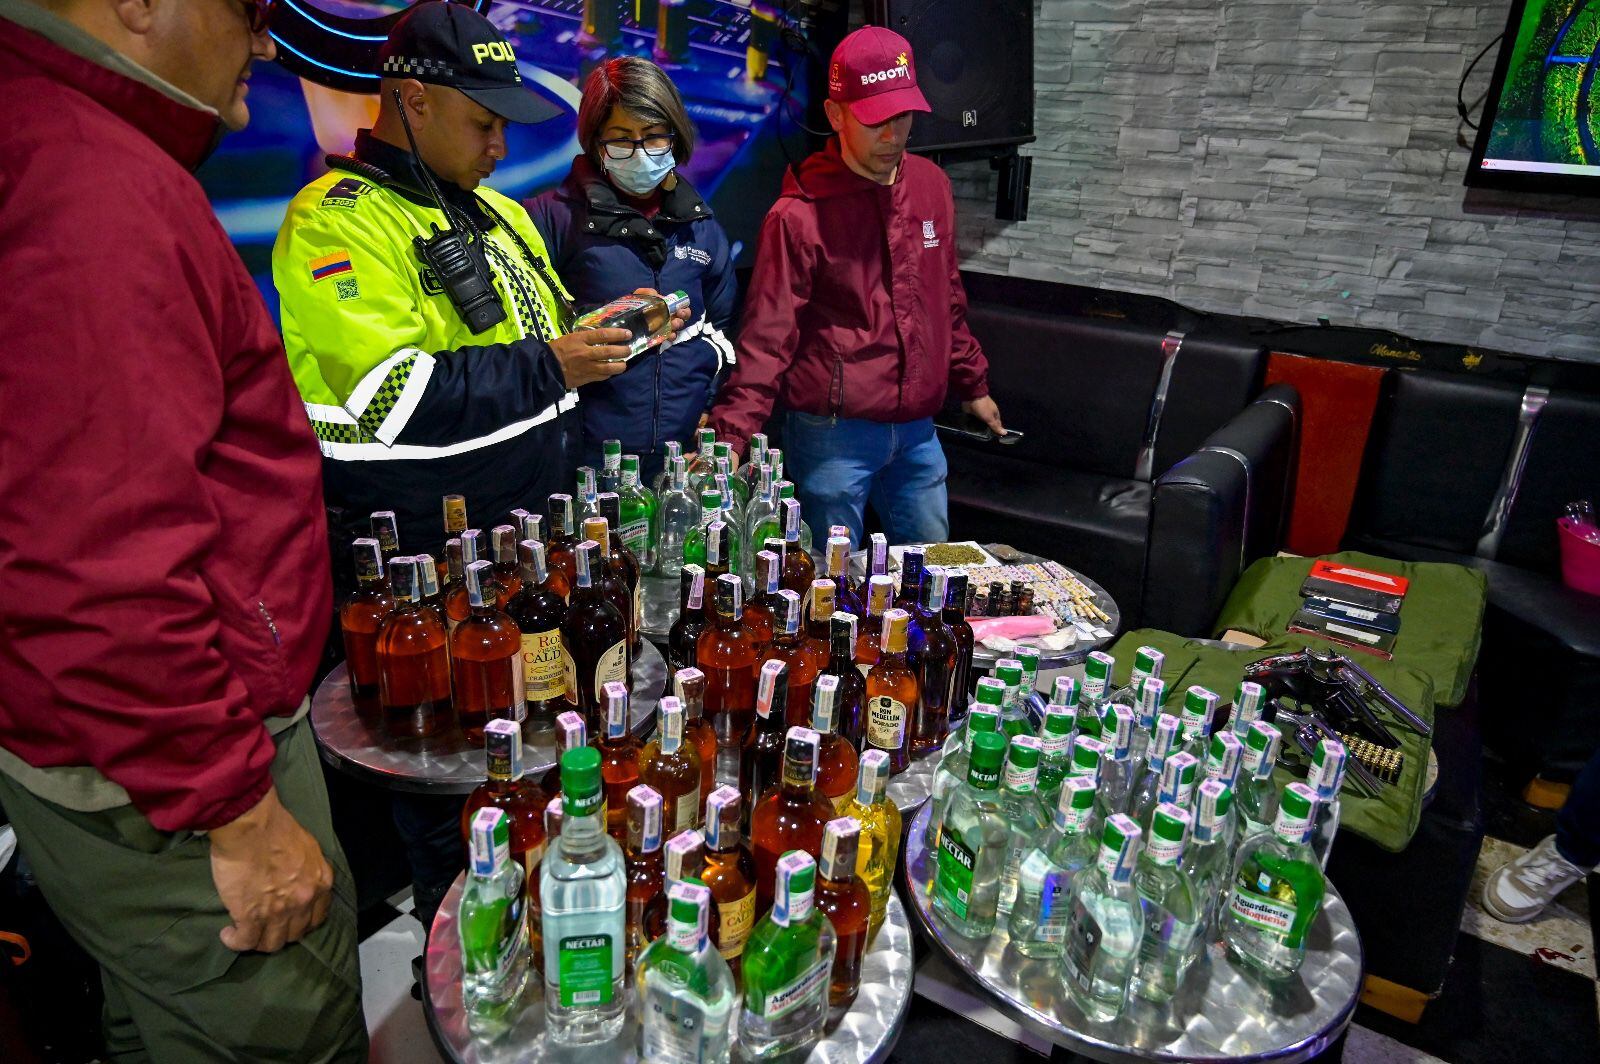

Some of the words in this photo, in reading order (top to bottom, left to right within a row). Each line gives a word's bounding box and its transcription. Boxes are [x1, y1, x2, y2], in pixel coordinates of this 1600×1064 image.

[524, 649, 561, 664] CALD
[872, 718, 899, 728] DORADO
[970, 769, 998, 782] NECTAR
[575, 793, 601, 808] NECT
[940, 832, 972, 870] NECTAR
[1235, 894, 1288, 919] Aguardiente
[565, 938, 606, 949] NECTAR
